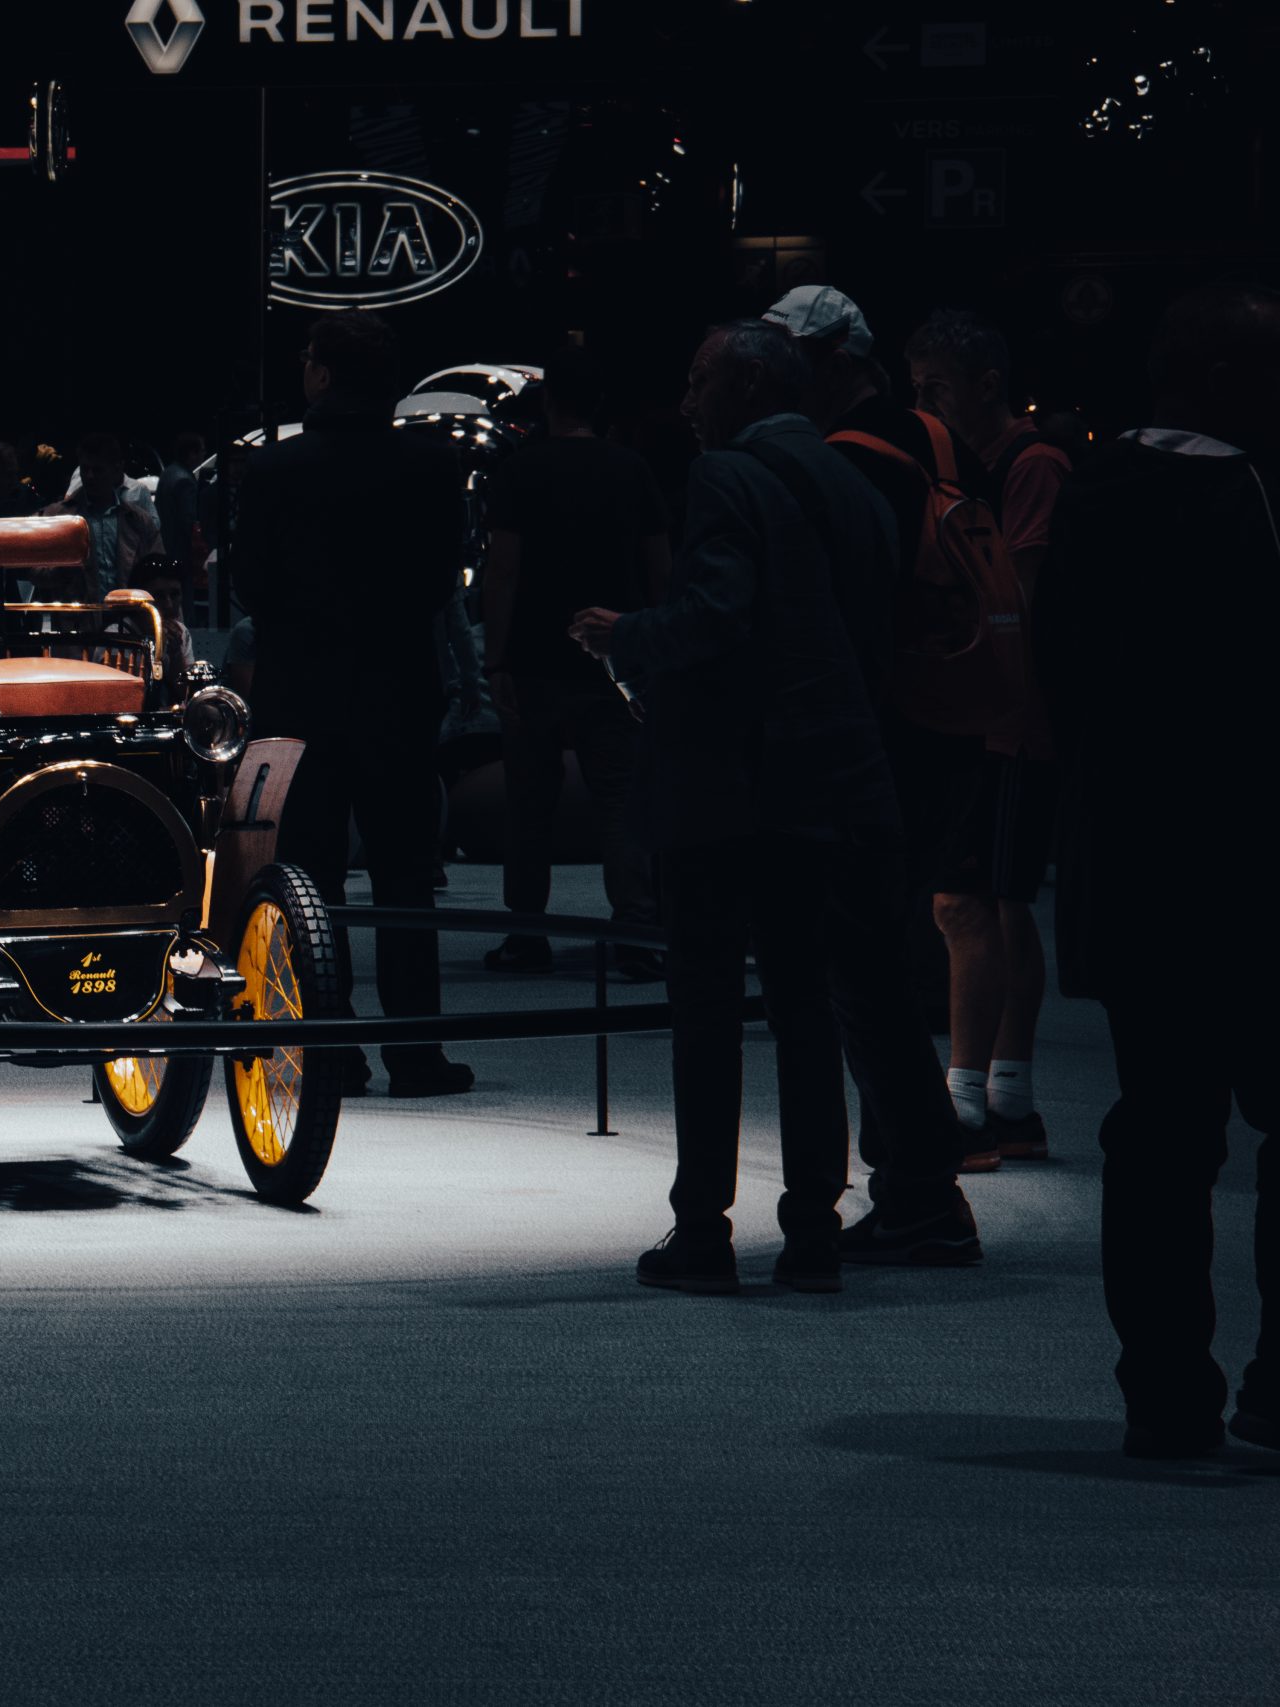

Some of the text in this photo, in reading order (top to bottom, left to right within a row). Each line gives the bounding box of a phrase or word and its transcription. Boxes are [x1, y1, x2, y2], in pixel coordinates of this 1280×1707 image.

[238, 0, 584, 43] RENAULT
[892, 119, 1036, 139] VERS PARKING
[269, 202, 437, 278] KIA
[68, 967, 118, 981] Renault
[69, 979, 117, 995] 1898
